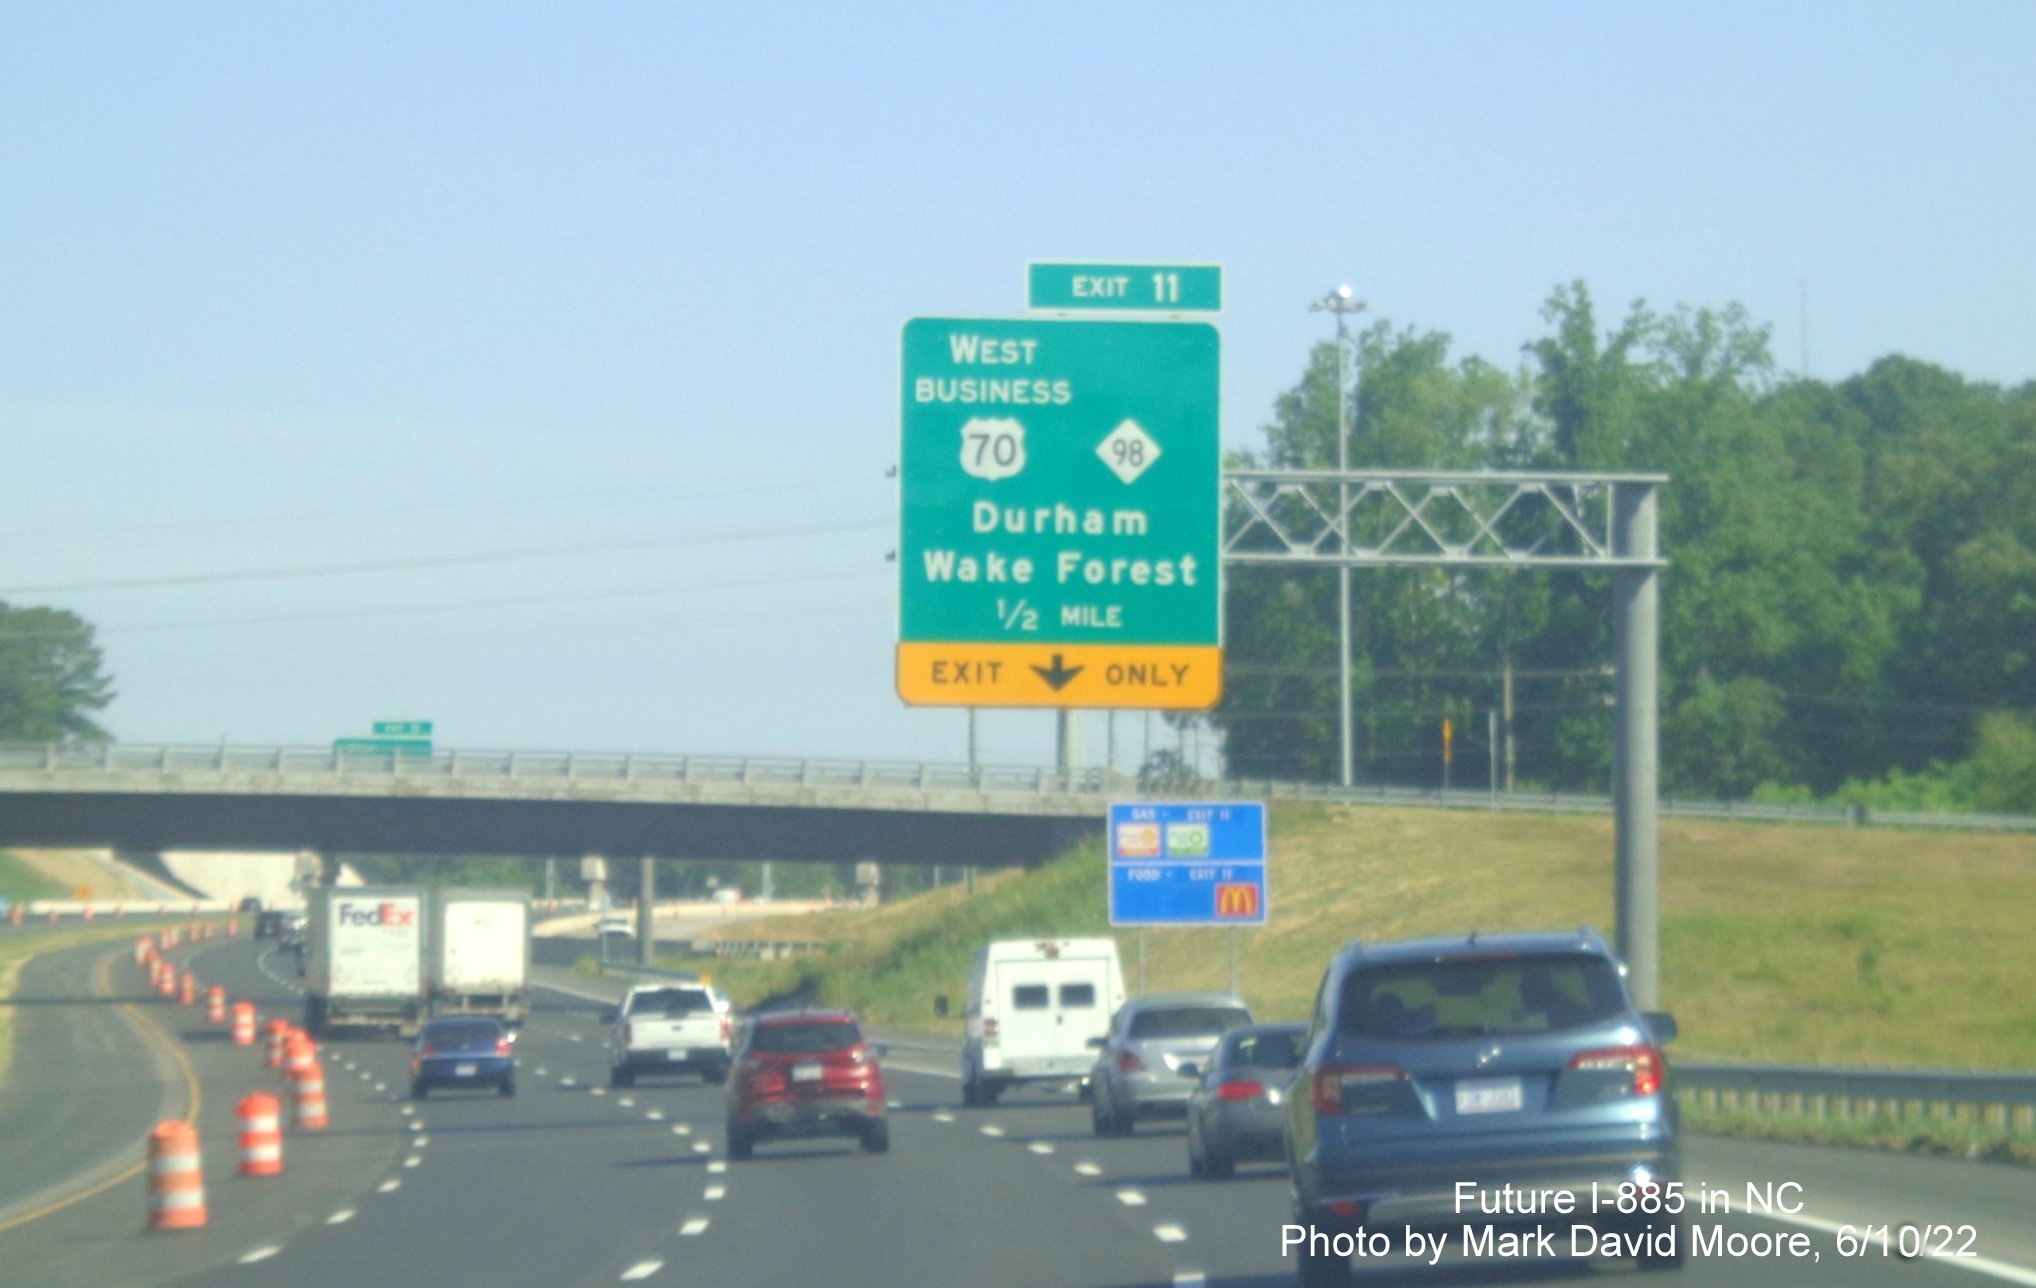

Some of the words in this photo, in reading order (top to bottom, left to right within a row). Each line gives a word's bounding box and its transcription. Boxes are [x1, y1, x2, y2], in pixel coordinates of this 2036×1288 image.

[1071, 275, 1130, 298] EXIT
[1153, 273, 1179, 303] 11
[949, 333, 1038, 364] WEST
[914, 377, 1073, 405] BUSINESS
[967, 433, 1018, 467] 70
[1111, 437, 1145, 468] 98
[972, 500, 1148, 535] Durham
[922, 549, 1034, 583] Wake
[1056, 551, 1198, 586] Forest
[1060, 604, 1123, 628] MILE
[930, 660, 1004, 684] EXIT
[1105, 662, 1191, 687] ONLY
[338, 902, 414, 927] FedEx
